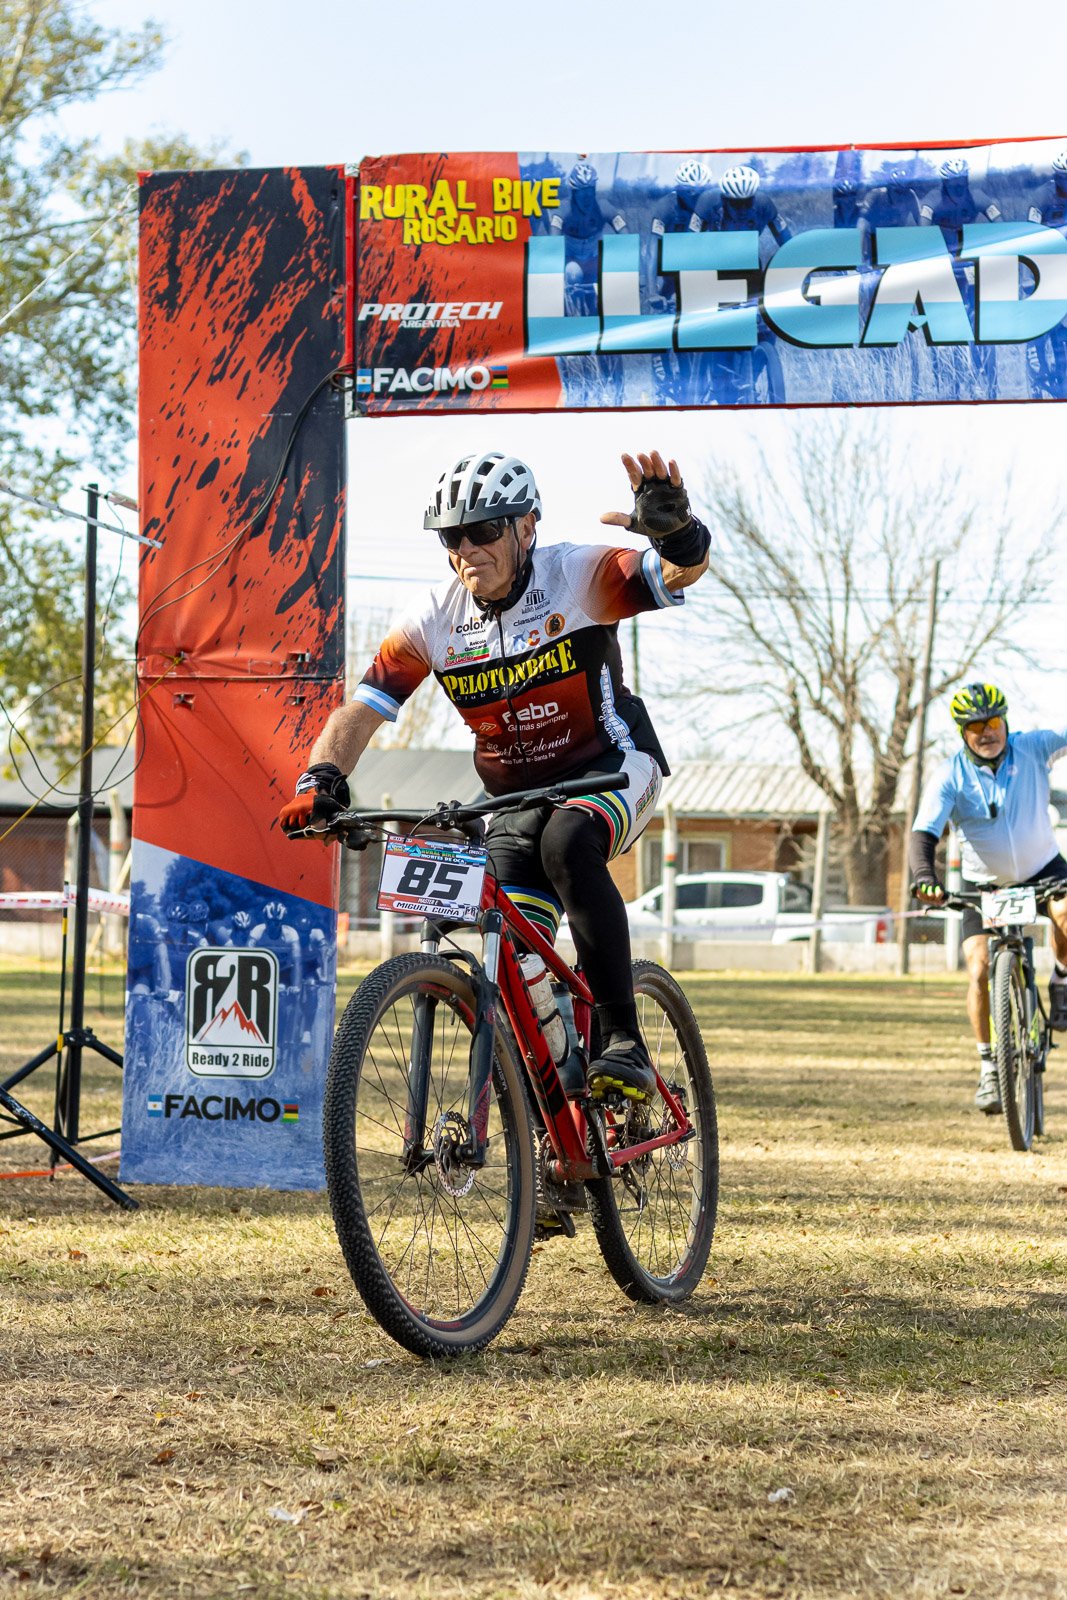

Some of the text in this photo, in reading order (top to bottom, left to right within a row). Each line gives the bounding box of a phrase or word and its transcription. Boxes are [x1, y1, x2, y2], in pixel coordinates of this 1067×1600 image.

[360, 178, 561, 220] RURAL BIKE
[402, 214, 518, 245] ROSARIO
[524, 222, 1067, 356] LLEGAD
[358, 301, 504, 321] PROTECH
[398, 319, 461, 328] ARGENTINA
[373, 365, 491, 393] FACIMO
[443, 638, 577, 701] PELOTONBIKE
[396, 859, 470, 901] 85
[396, 902, 428, 912] MIGUEL
[995, 898, 1024, 916] 75
[192, 1052, 270, 1067] Ready 2 Ride
[164, 1094, 281, 1123] FACIMO
